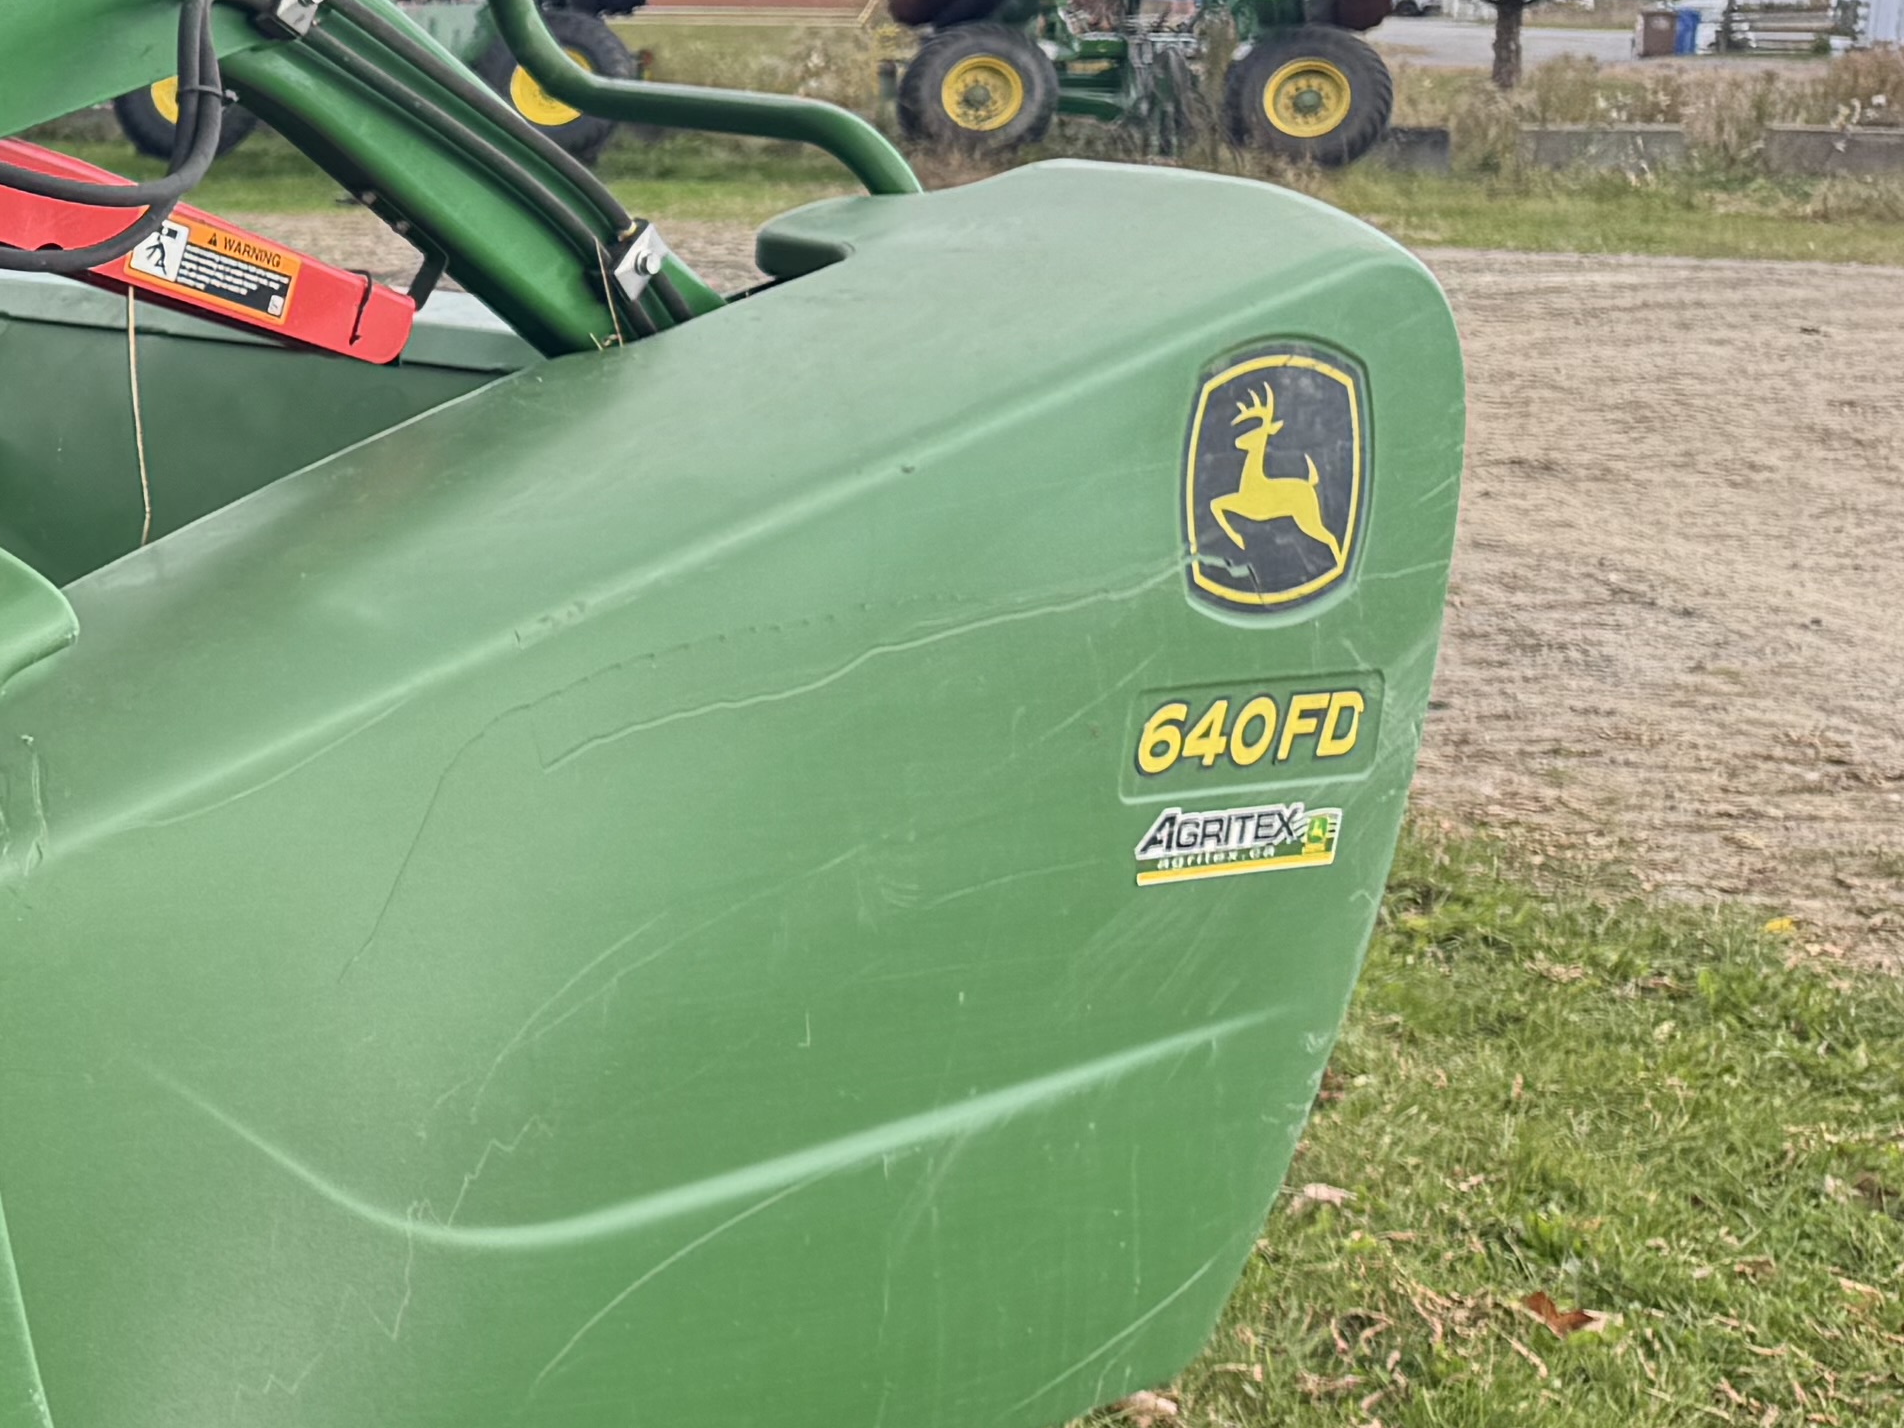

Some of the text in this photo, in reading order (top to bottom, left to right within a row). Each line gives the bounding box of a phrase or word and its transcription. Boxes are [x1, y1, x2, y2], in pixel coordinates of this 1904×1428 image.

[223, 235, 282, 268] WARNING
[1136, 689, 1365, 775] 640FD
[1139, 805, 1302, 856] AGRITEX
